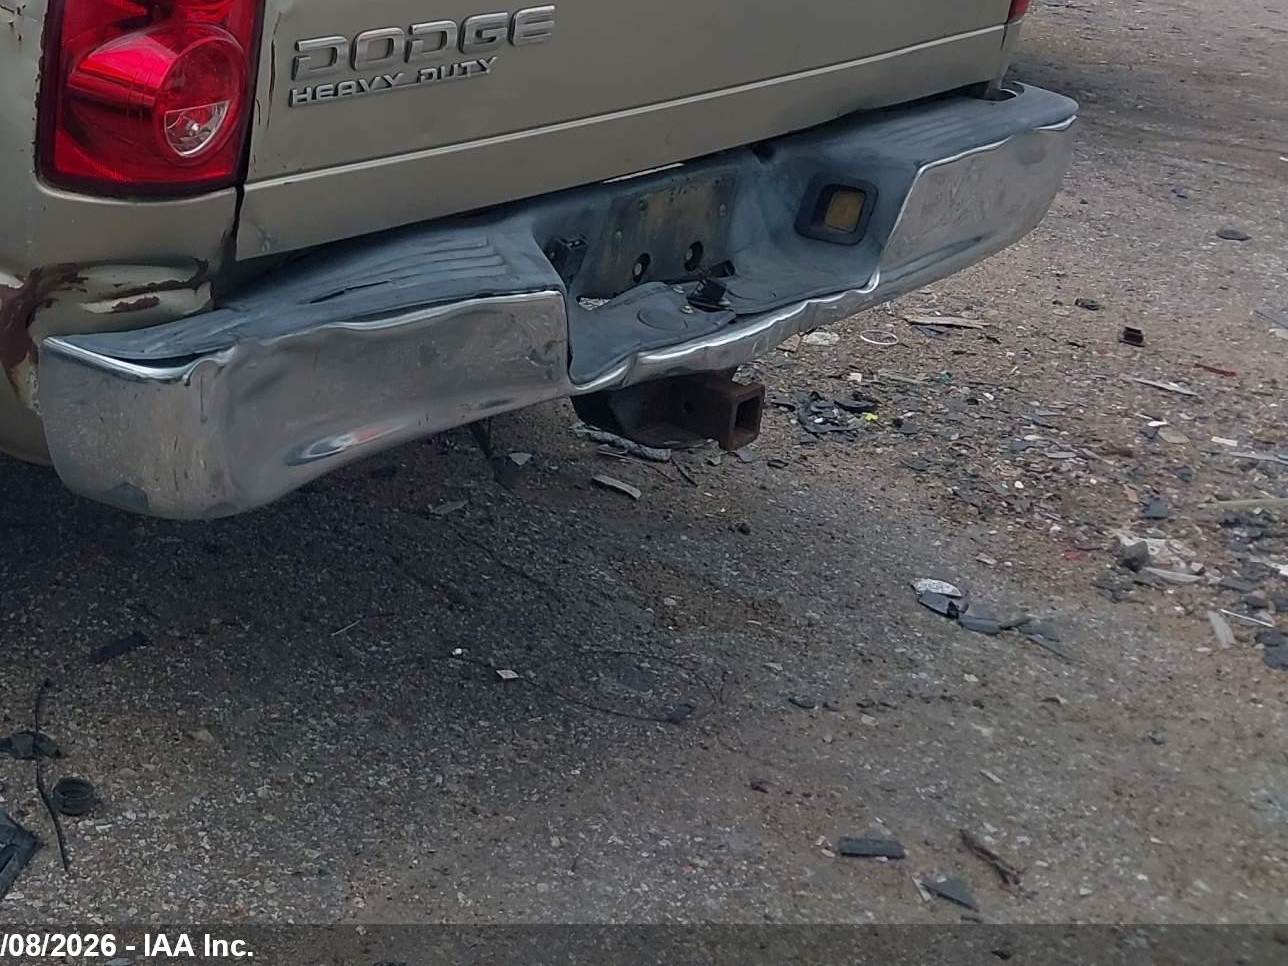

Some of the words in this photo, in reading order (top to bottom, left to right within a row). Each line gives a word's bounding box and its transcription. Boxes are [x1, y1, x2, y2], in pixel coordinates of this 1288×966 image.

[290, 4, 556, 82] DODGE
[288, 72, 405, 107] HEAVY
[417, 55, 497, 84] DUTY
